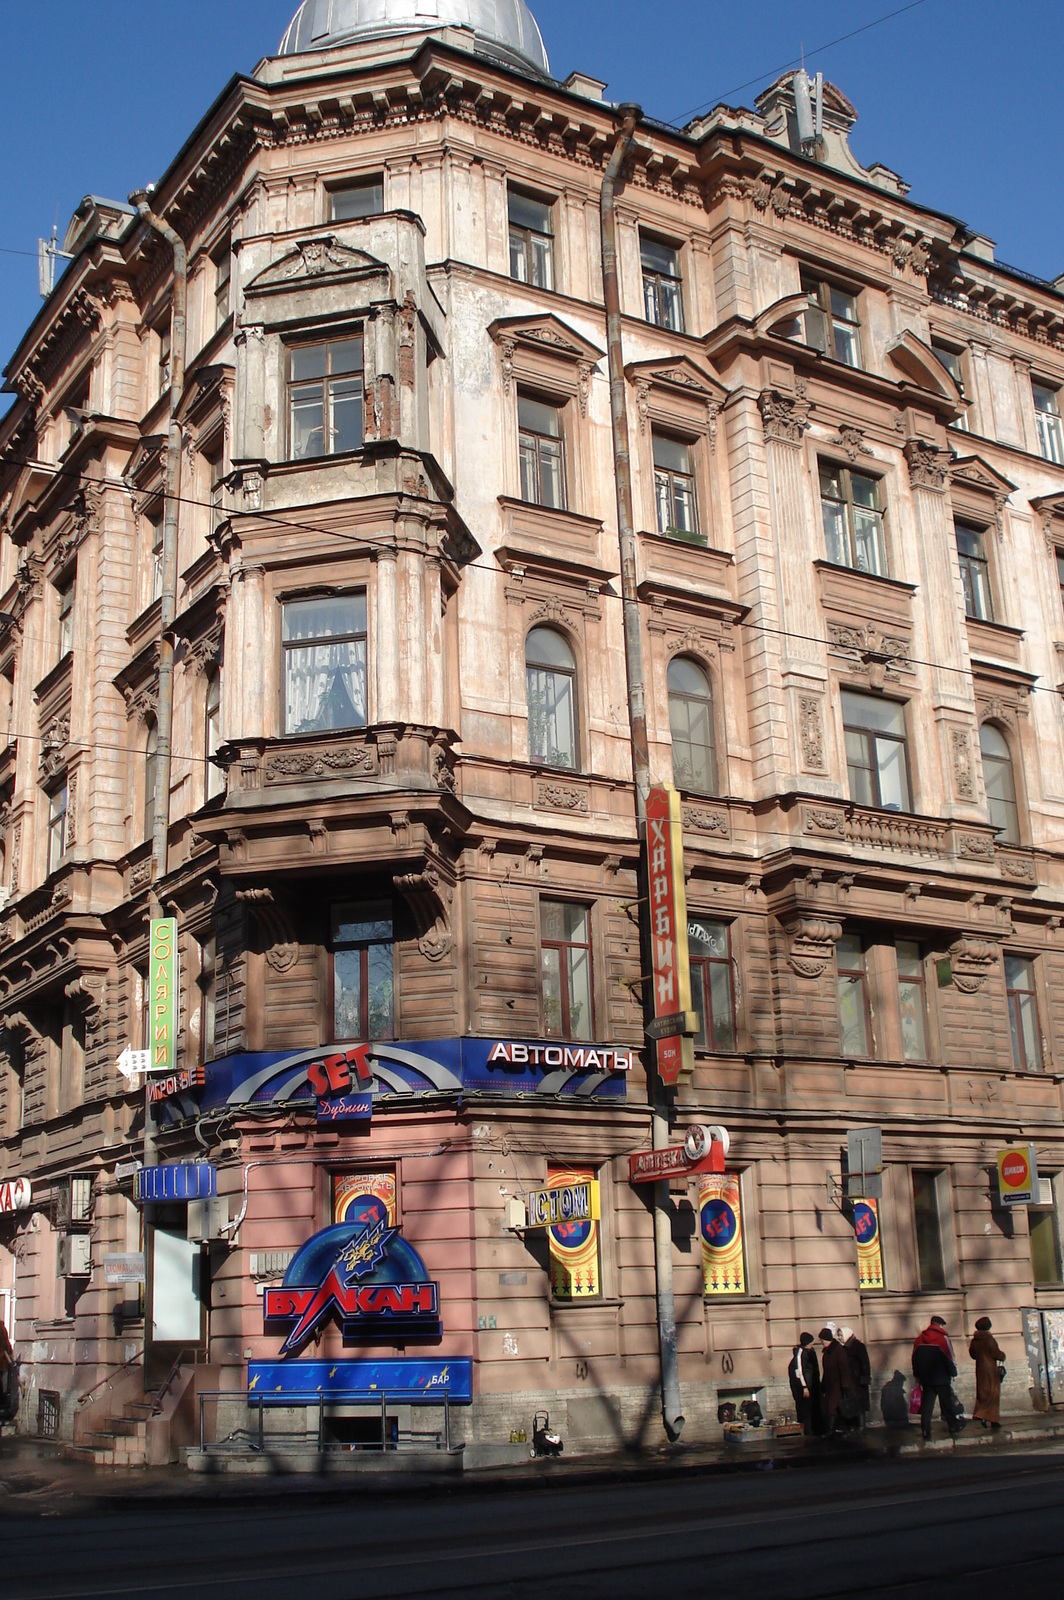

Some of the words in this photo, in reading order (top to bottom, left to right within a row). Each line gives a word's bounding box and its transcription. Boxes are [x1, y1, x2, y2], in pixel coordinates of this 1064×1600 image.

[650, 817, 675, 1005] ХАРБИН
[154, 923, 171, 1066] СОЛЯРИЙ
[307, 1043, 371, 1096] SET
[490, 1042, 633, 1071] АВТОМАТЫ
[318, 1097, 370, 1120] Дублин
[637, 1149, 688, 1171] АПТЕКА
[337, 1181, 395, 1193] АВТОМАТЫ
[342, 1173, 389, 1183] ИГРОВЫЕ
[536, 1184, 589, 1225] СТОМ
[558, 1220, 583, 1238] SE
[706, 1211, 730, 1238] SET
[266, 1272, 433, 1341] ВУЛКАН
[431, 1375, 450, 1385] БАР
